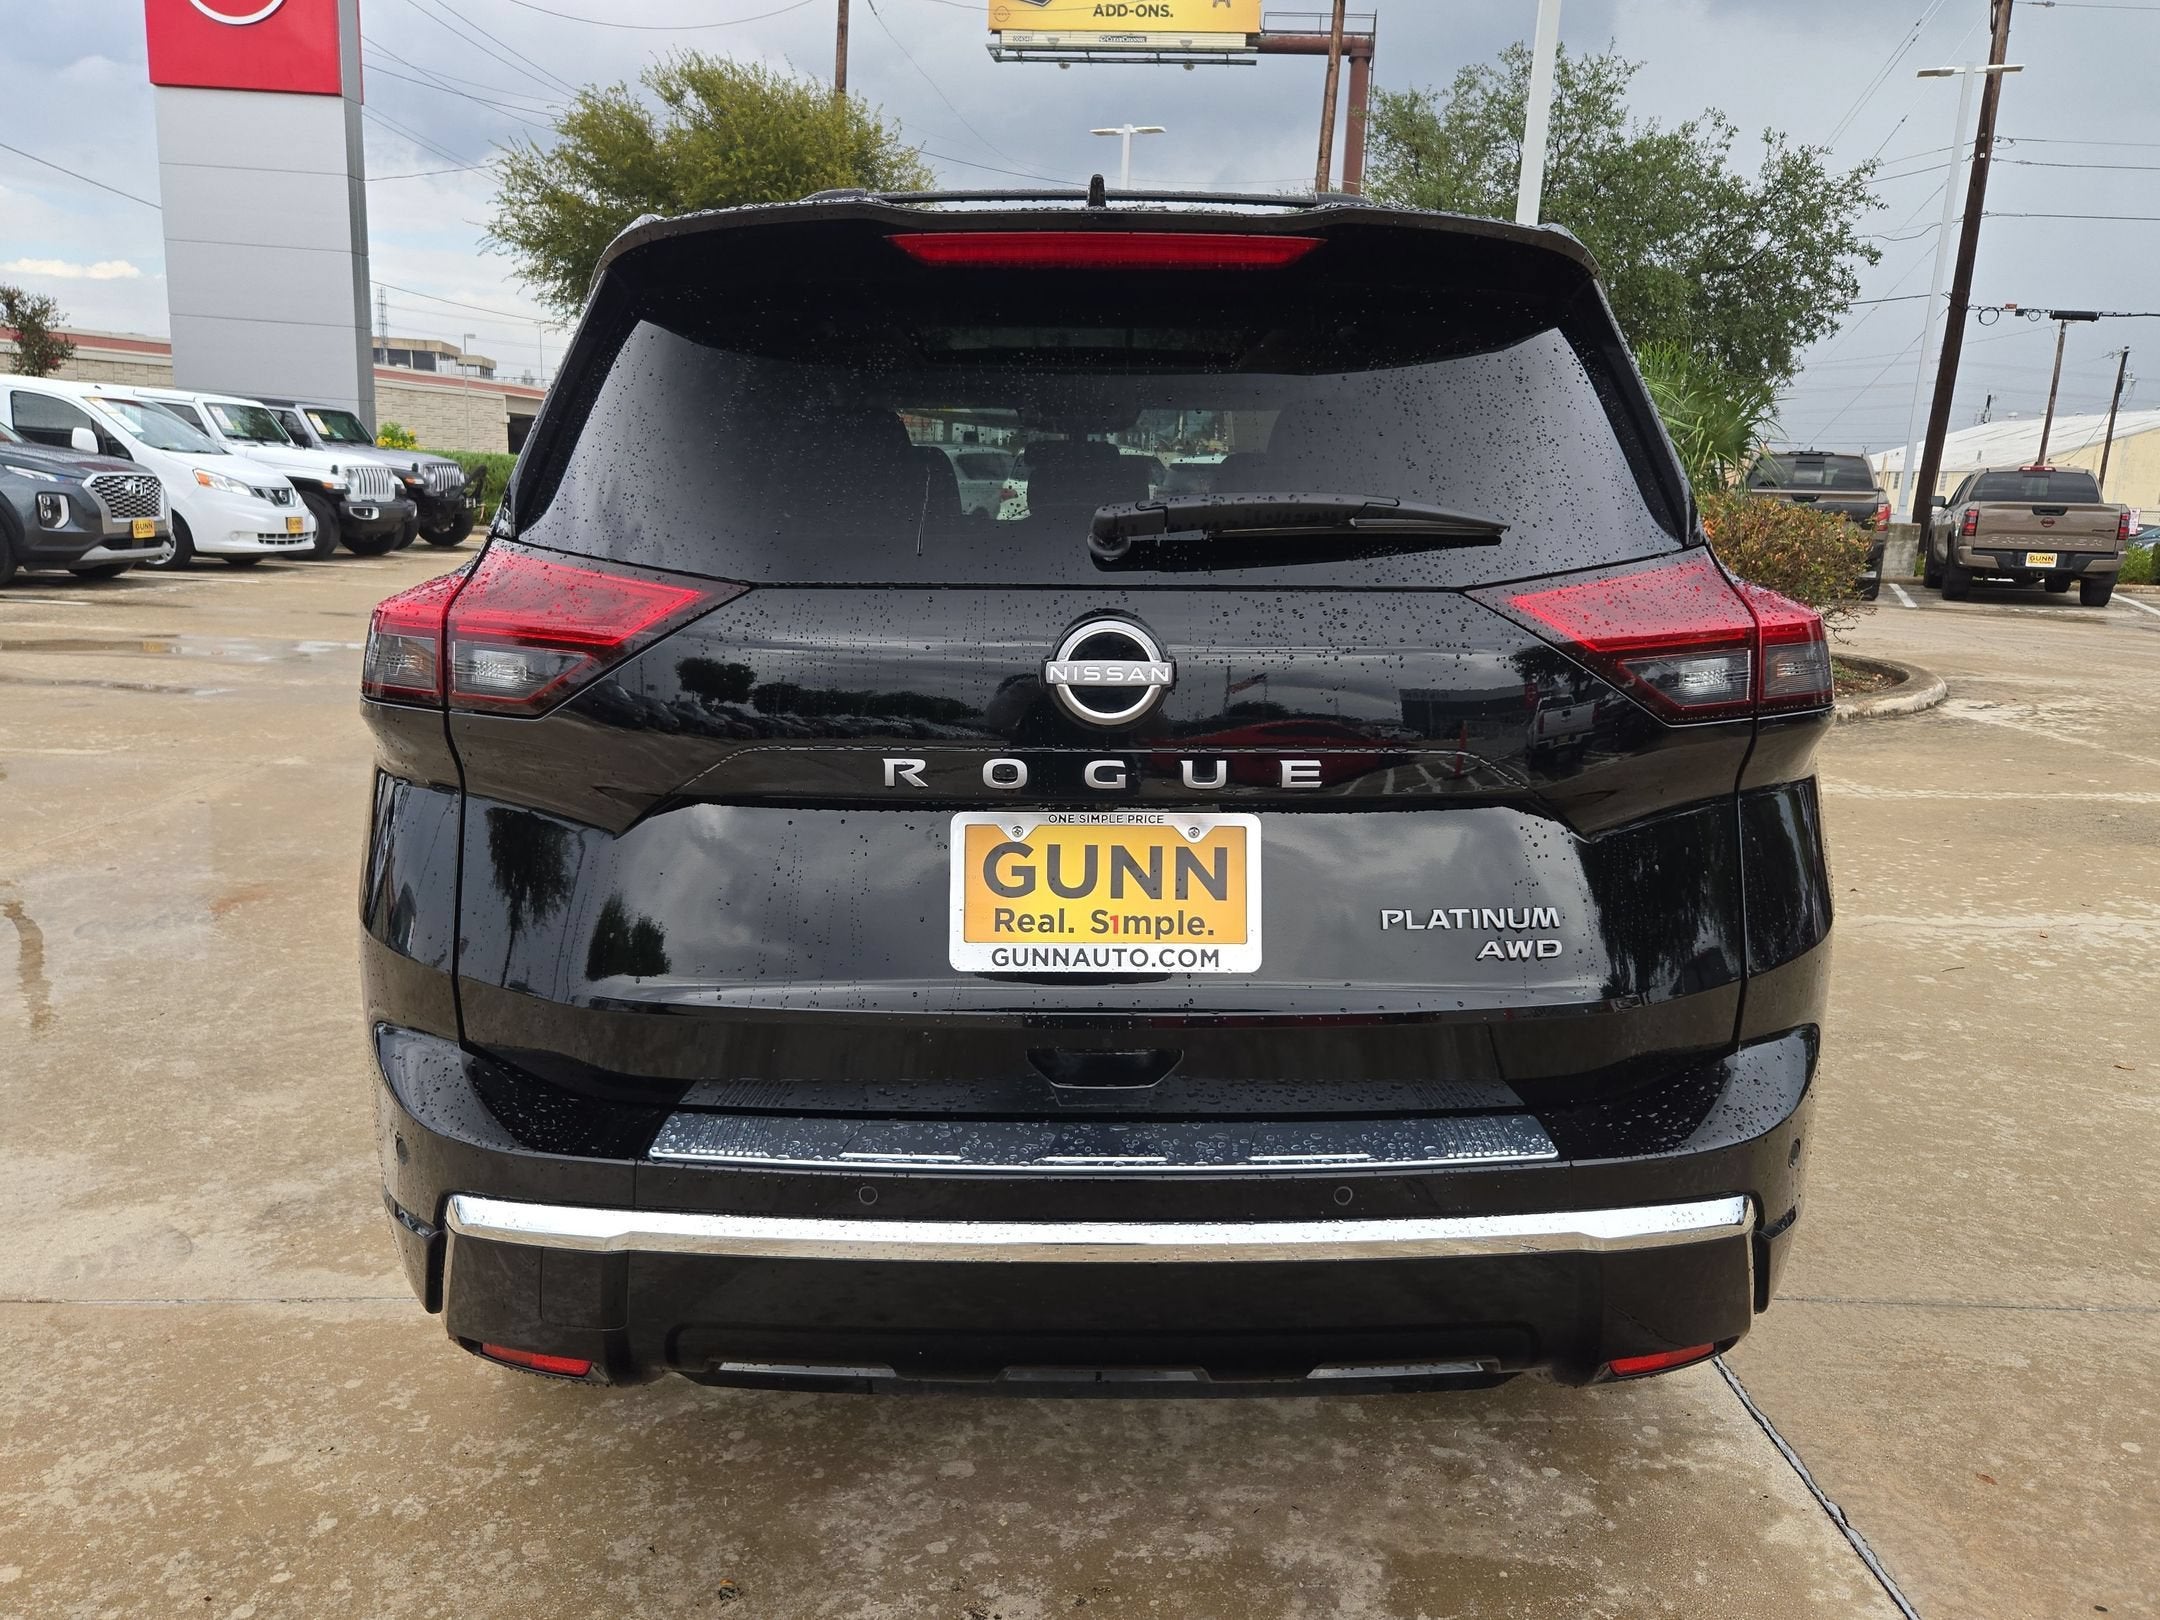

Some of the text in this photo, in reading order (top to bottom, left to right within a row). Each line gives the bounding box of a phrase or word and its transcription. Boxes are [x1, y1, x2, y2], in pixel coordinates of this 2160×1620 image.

[1093, 3, 1174, 18] ADD-ONS.
[1987, 535, 2103, 547] FRONTIER
[1049, 665, 1170, 682] NISSAN
[882, 757, 1323, 790] ROGUE
[1048, 814, 1165, 824] ONE SIMPLE PRICE
[982, 841, 1228, 901] GUNN
[994, 907, 1075, 934] Real.
[1381, 907, 1561, 930] PLATINUM
[991, 947, 1220, 968] GUNNAUTO.COM
[1476, 939, 1563, 960] AWD
